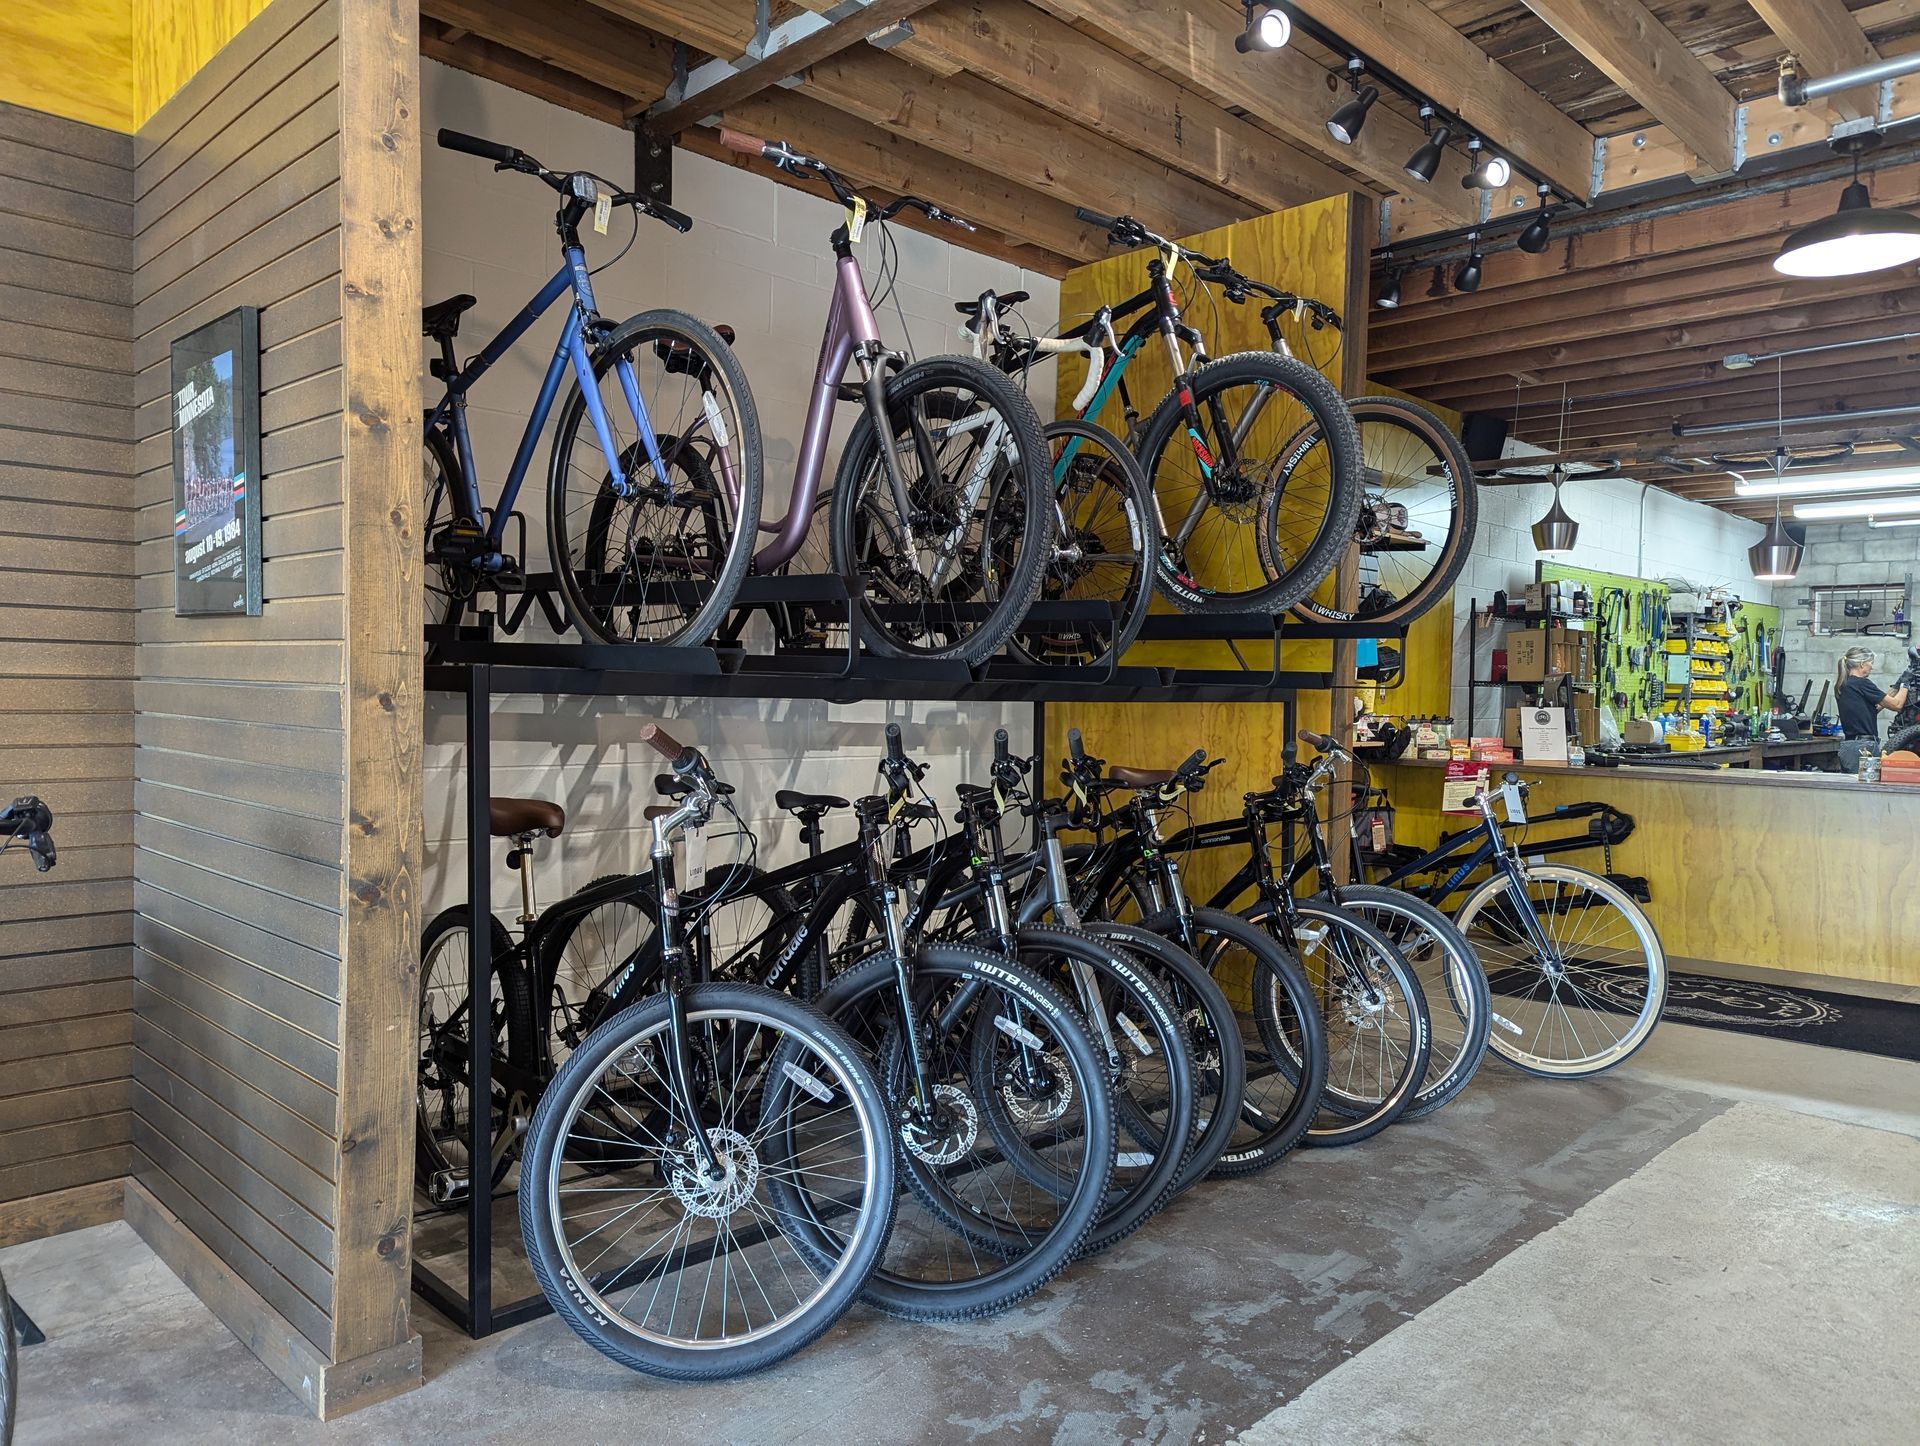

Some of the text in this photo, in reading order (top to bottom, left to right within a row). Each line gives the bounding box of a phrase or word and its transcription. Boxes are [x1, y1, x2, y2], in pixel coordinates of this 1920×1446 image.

[178, 381, 194, 409] TOUR
[179, 385, 214, 429] MINNESOTA
[1283, 441, 1312, 476] WHISKY
[1441, 460, 1456, 501] WHISKY
[184, 538, 206, 564] august
[1172, 584, 1200, 602] WTB
[1318, 607, 1355, 621] WHISKY
[1201, 834, 1231, 844] cannondale
[1446, 863, 1471, 889] LINUS
[979, 962, 1054, 1012] WTB RANGER
[1114, 963, 1149, 993] WTB
[1145, 991, 1171, 1026] RANGER
[1421, 1073, 1458, 1101] KENDA
[1227, 1149, 1259, 1163] WTB
[559, 1266, 609, 1326] KENDA
